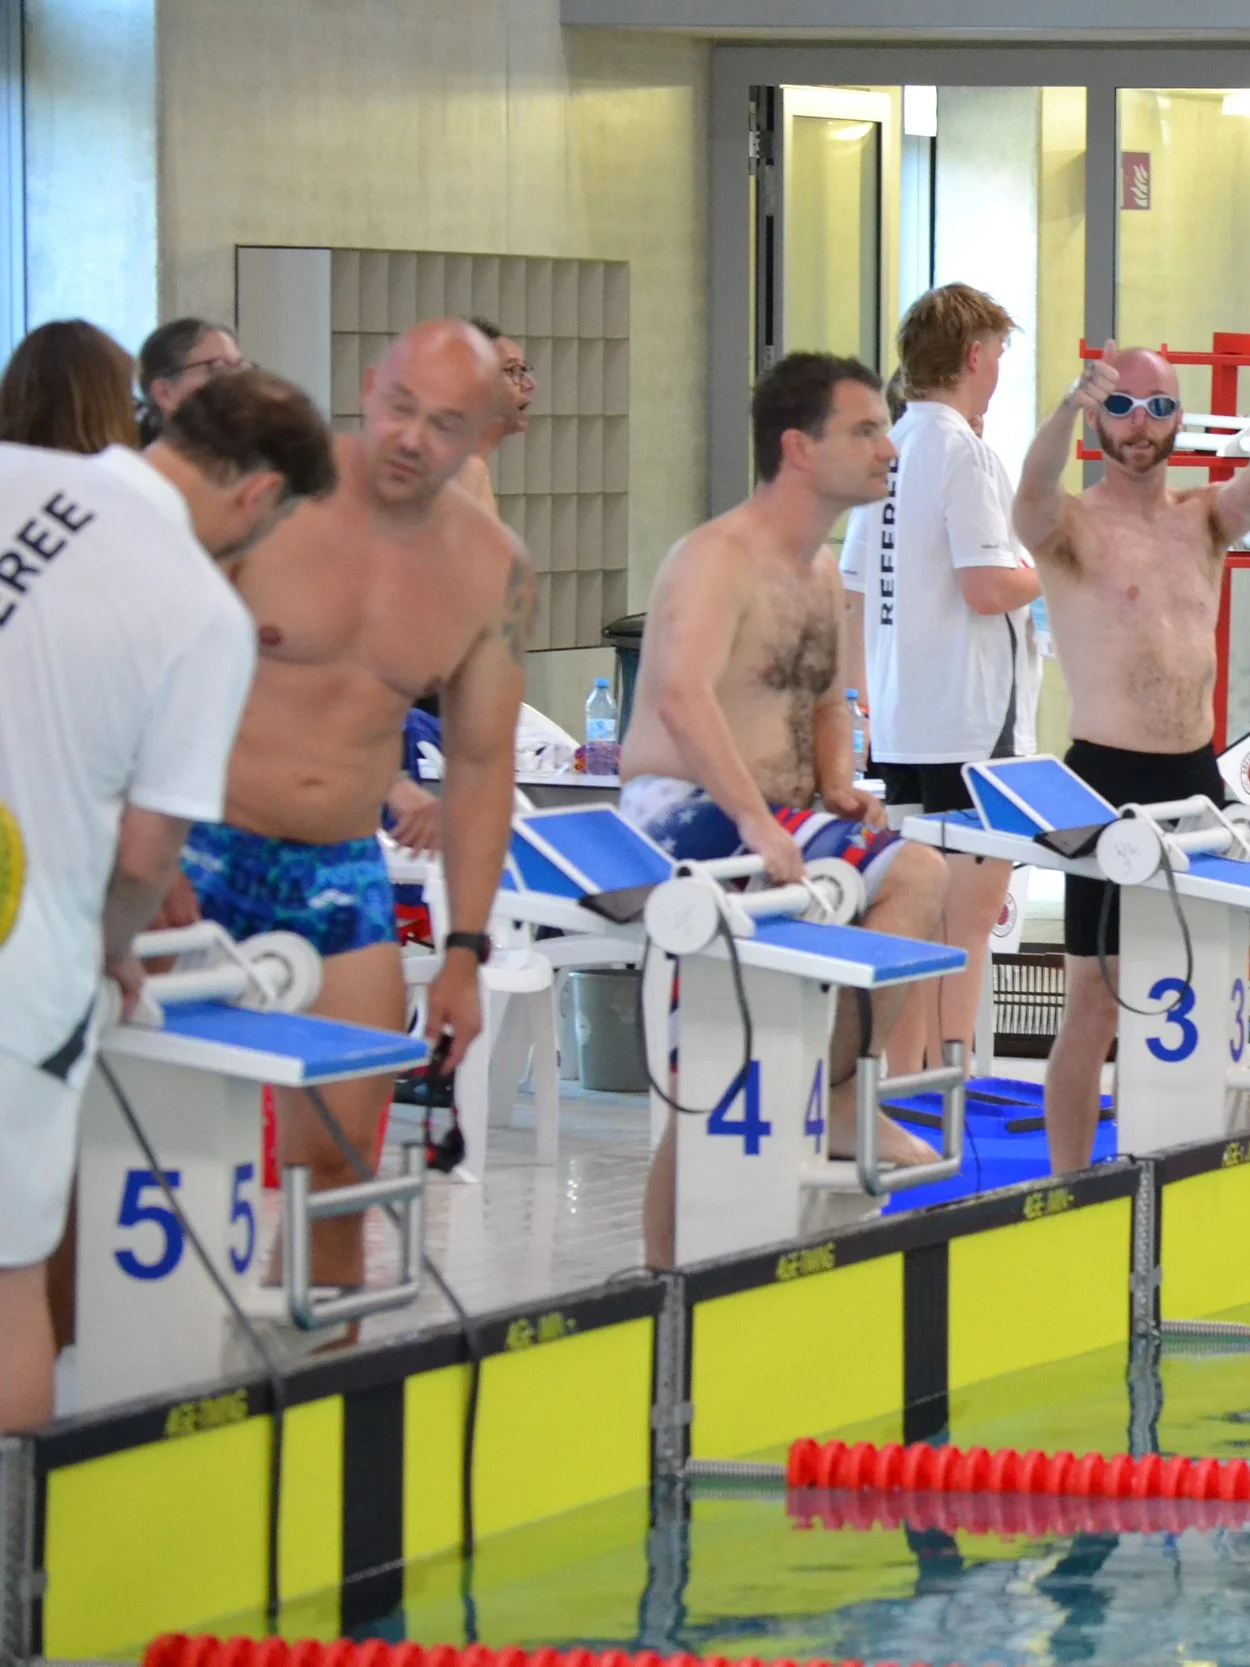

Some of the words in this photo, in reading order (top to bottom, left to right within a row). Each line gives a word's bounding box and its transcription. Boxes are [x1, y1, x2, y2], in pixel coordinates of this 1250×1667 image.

[1146, 977, 1198, 1062] 3
[1230, 978, 1245, 1063] 3
[707, 1060, 772, 1155] 4
[804, 1059, 824, 1154] 4
[114, 1169, 185, 1280] 5
[230, 1163, 255, 1275] 5
